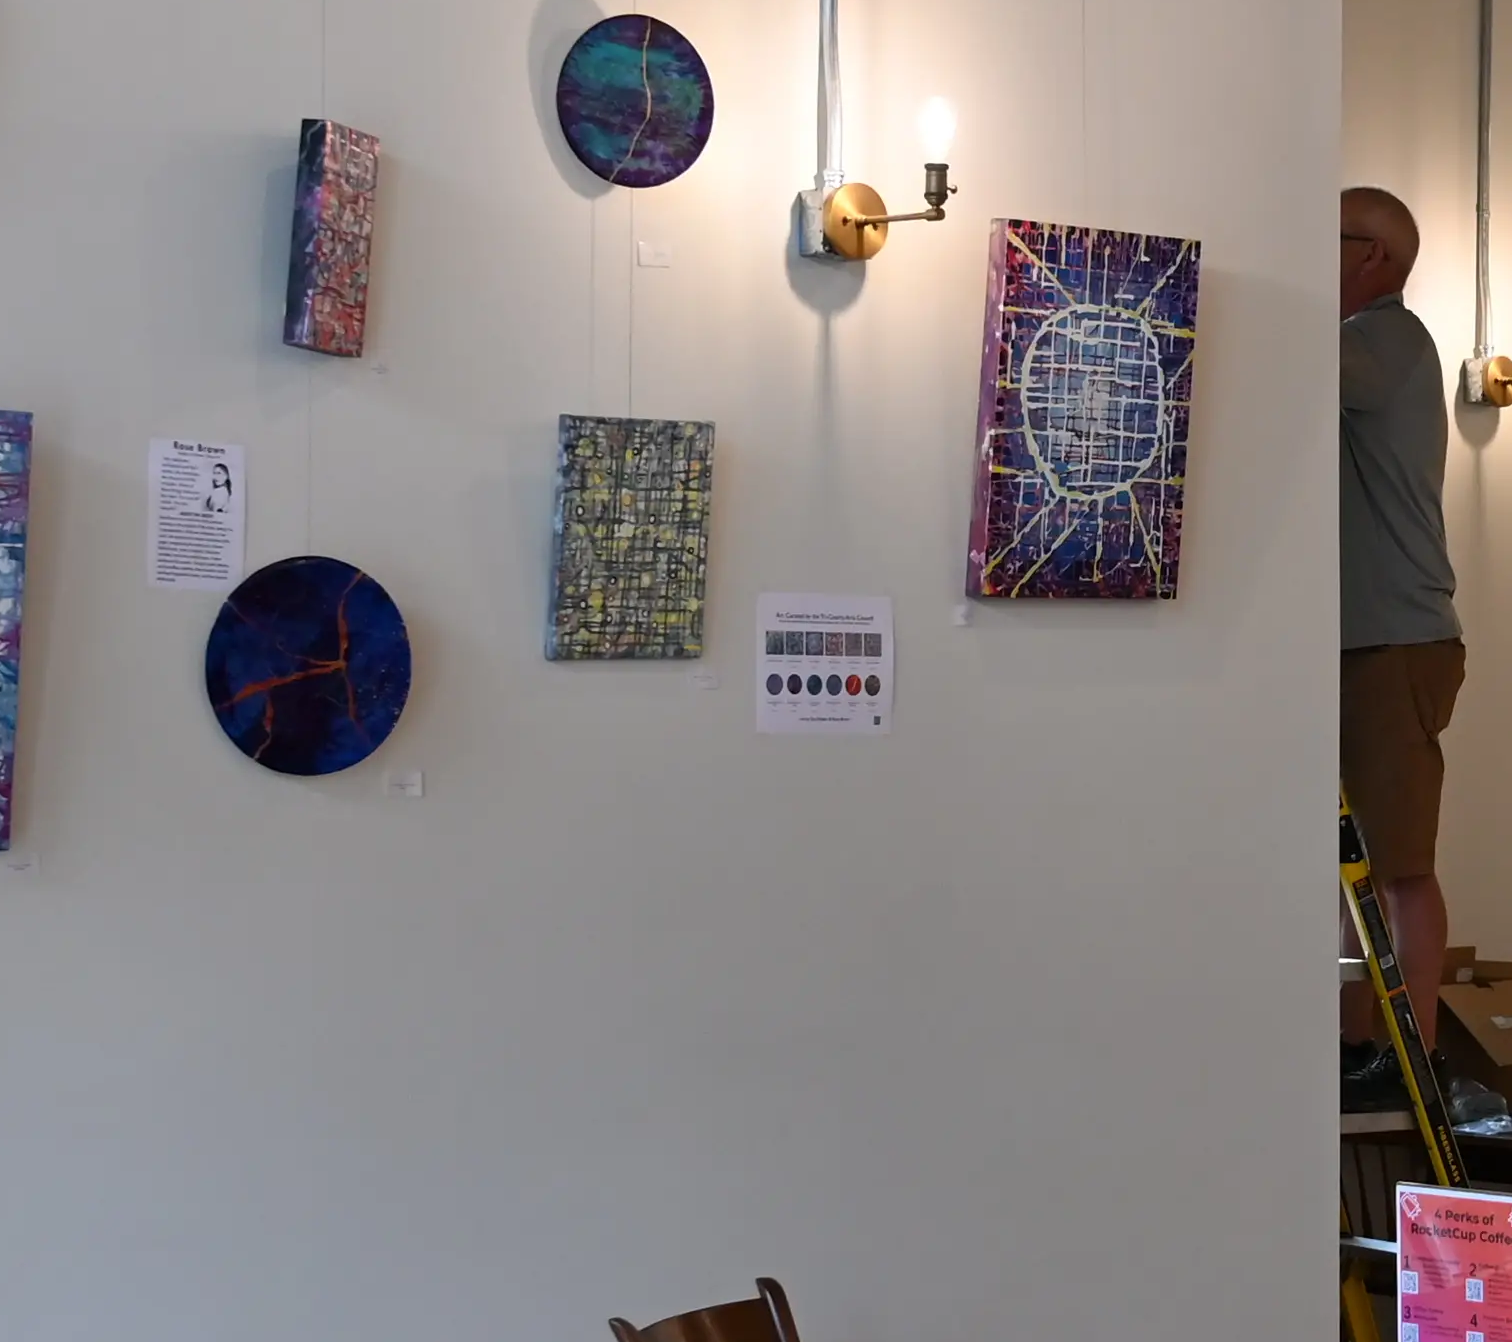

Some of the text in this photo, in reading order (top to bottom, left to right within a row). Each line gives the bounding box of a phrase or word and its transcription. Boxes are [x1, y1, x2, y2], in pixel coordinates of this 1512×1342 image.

[197, 443, 226, 455] Brown
[1437, 1124, 1461, 1183] FIBERGLASS
[1434, 1209, 1495, 1226] 4 Perks of
[1411, 1222, 1477, 1244] RocketCup
[1404, 1255, 1411, 1269] 1
[1469, 1263, 1477, 1277] 2
[1404, 1305, 1412, 1320] 3
[1470, 1314, 1478, 1328] 4
